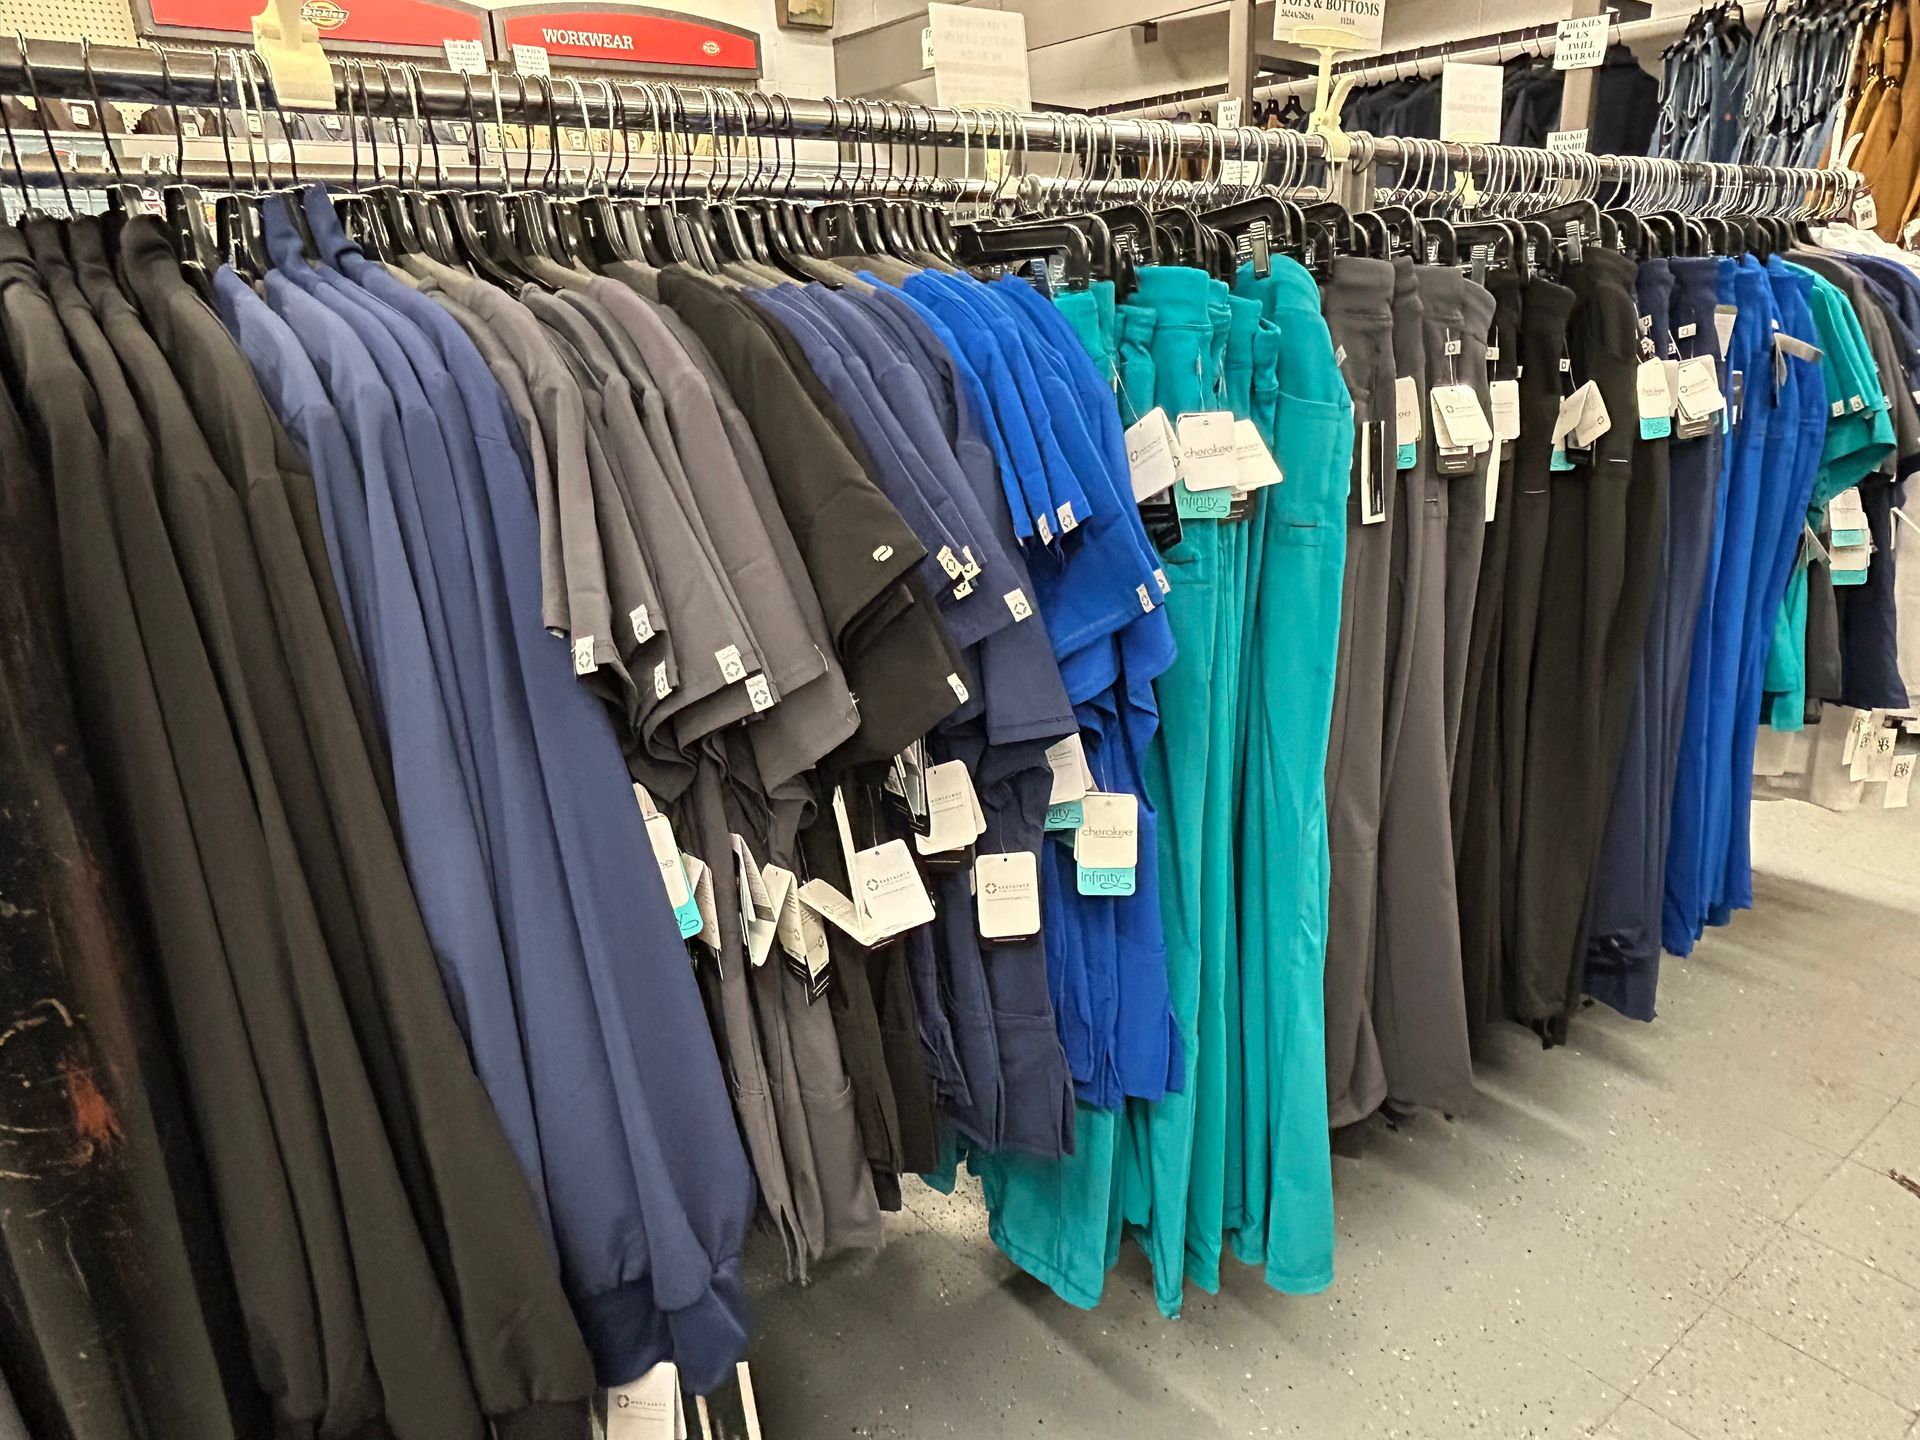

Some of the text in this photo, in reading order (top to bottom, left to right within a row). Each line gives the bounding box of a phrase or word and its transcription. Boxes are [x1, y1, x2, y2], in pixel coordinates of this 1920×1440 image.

[1314, 0, 1322, 9] &
[1326, 0, 1380, 17] BOTTOMS
[541, 27, 635, 51] WORKWEAR
[1183, 443, 1234, 459] cherokee
[1179, 494, 1219, 511] Infinity
[1081, 826, 1133, 838] cherokee
[1080, 870, 1123, 886] Infinity
